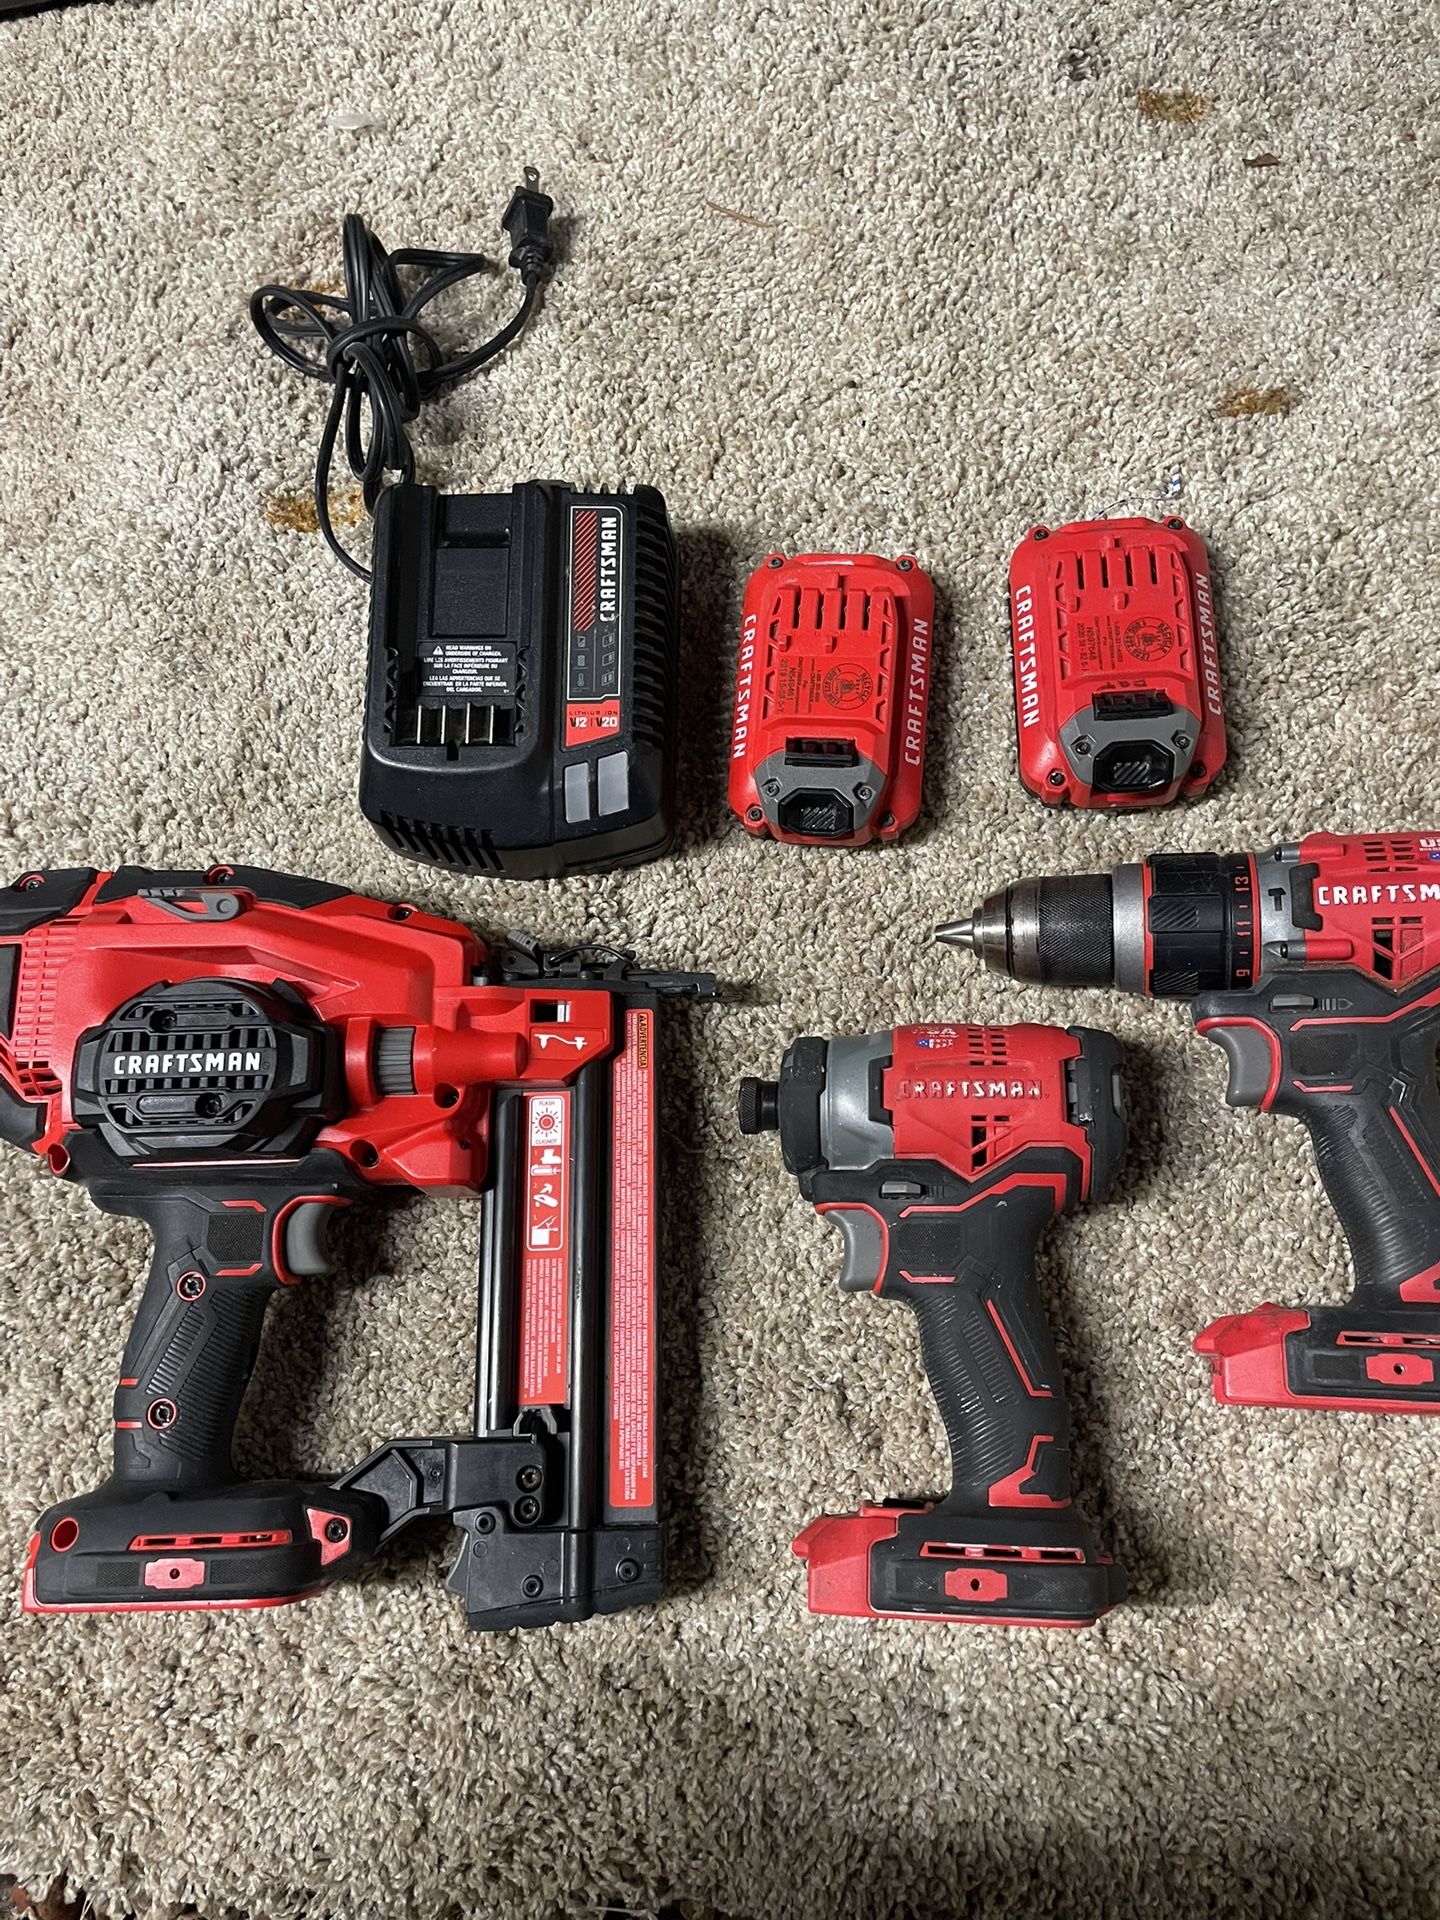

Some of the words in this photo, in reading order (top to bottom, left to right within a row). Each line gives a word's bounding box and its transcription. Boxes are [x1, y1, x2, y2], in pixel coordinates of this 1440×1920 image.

[600, 517, 617, 621] CRAFTSMAN
[1196, 572, 1221, 715] CRAFTSMAN
[1015, 585, 1039, 727] CRAFTSMAN
[733, 613, 757, 758] CRAFTSMAN
[905, 618, 928, 766] CRAFTSMAN
[596, 716, 618, 727] V20
[1235, 877, 1250, 891] 13
[1236, 921, 1251, 935] 11
[1236, 969, 1250, 977] 9
[113, 1052, 260, 1075] CRAFTSMAN
[900, 1079, 1042, 1099] CRAFTSMAN
